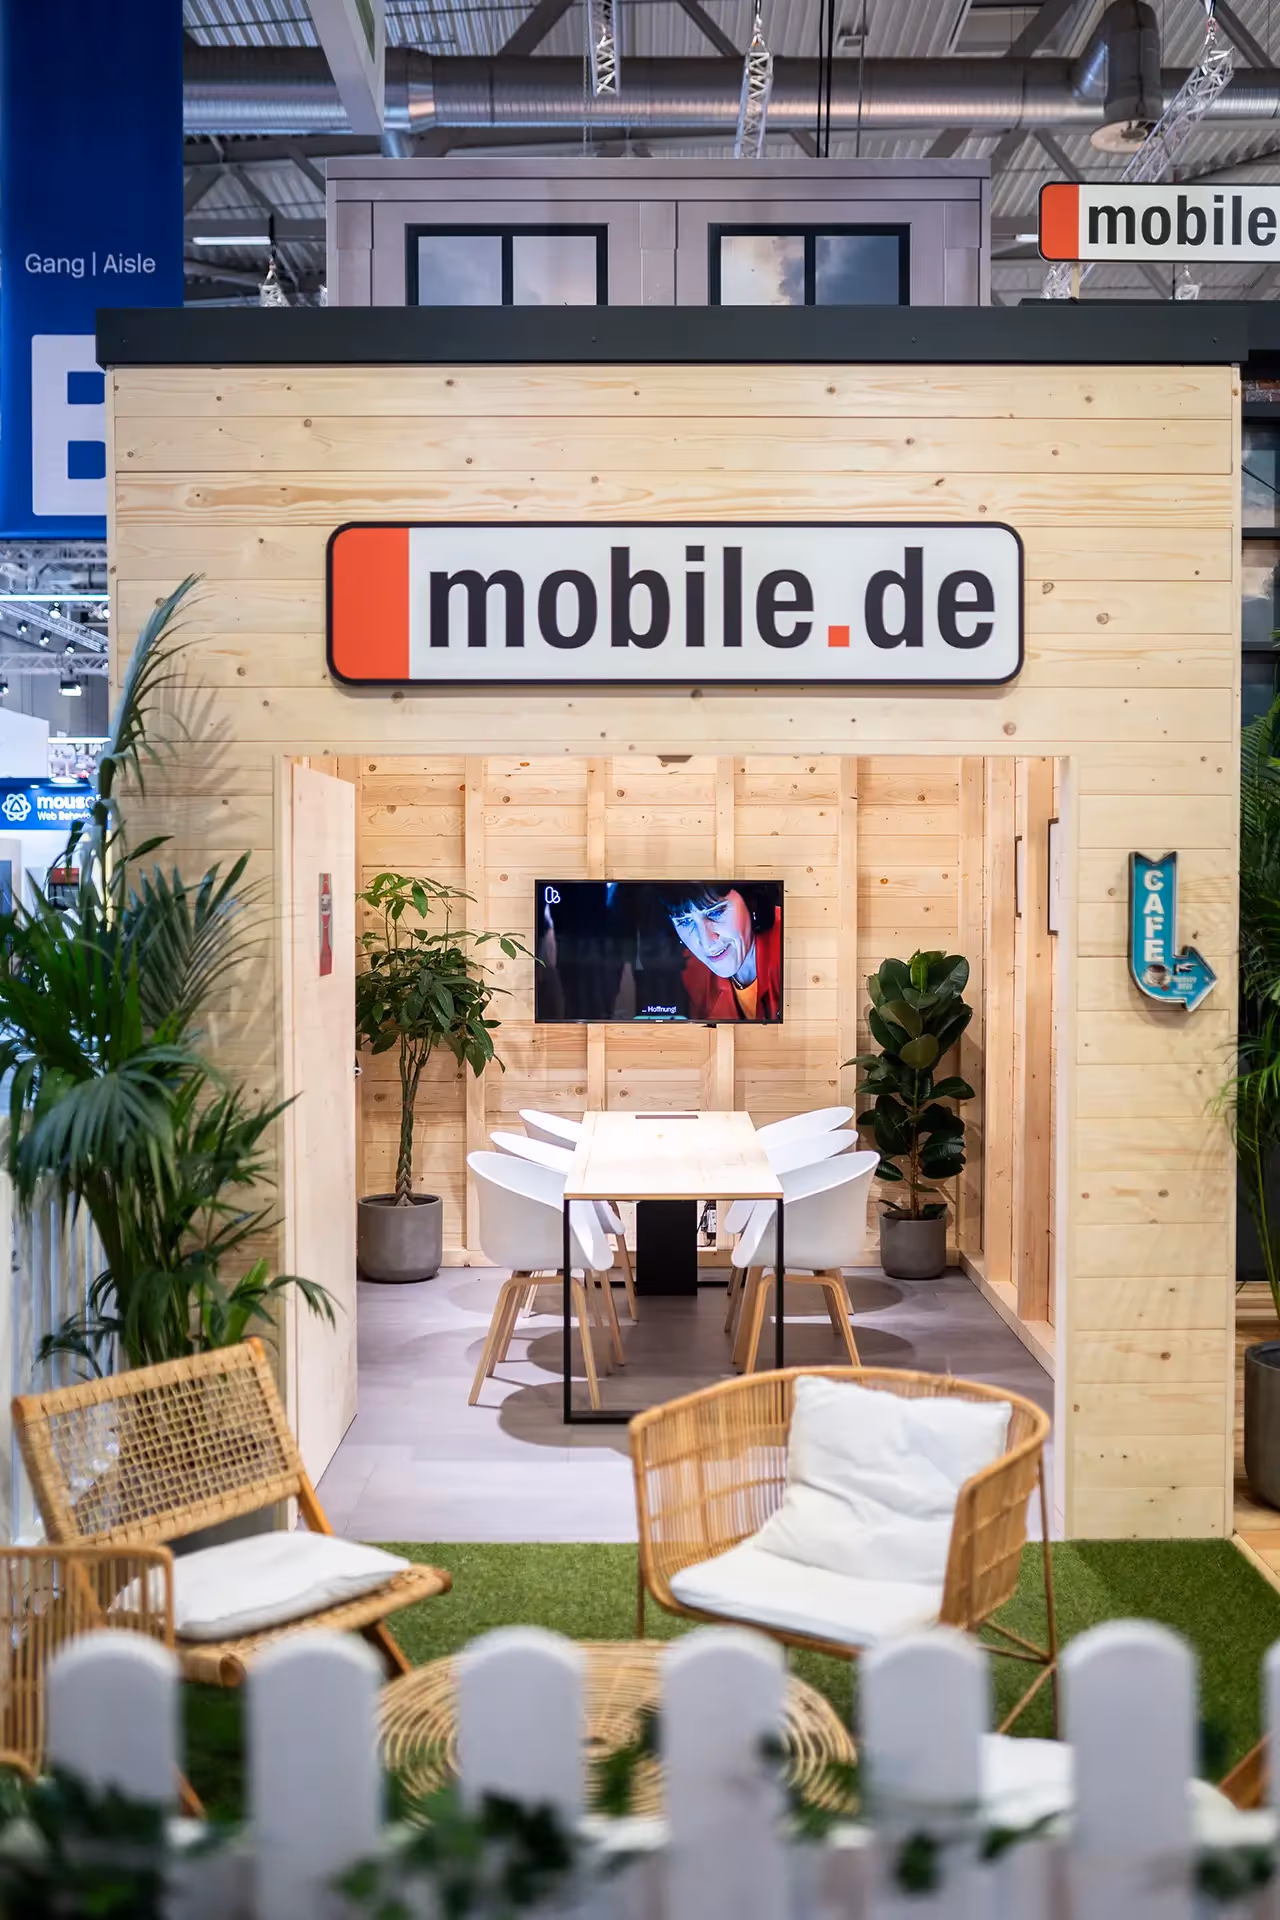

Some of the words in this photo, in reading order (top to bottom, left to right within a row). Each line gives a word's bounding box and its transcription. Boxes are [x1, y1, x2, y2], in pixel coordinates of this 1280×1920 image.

[1088, 194, 1277, 246] mobile
[25, 253, 85, 278] Gang
[103, 252, 156, 273] Aisle
[429, 545, 994, 649] mobile.de
[37, 811, 57, 821] Web
[1143, 870, 1165, 962] CAFE
